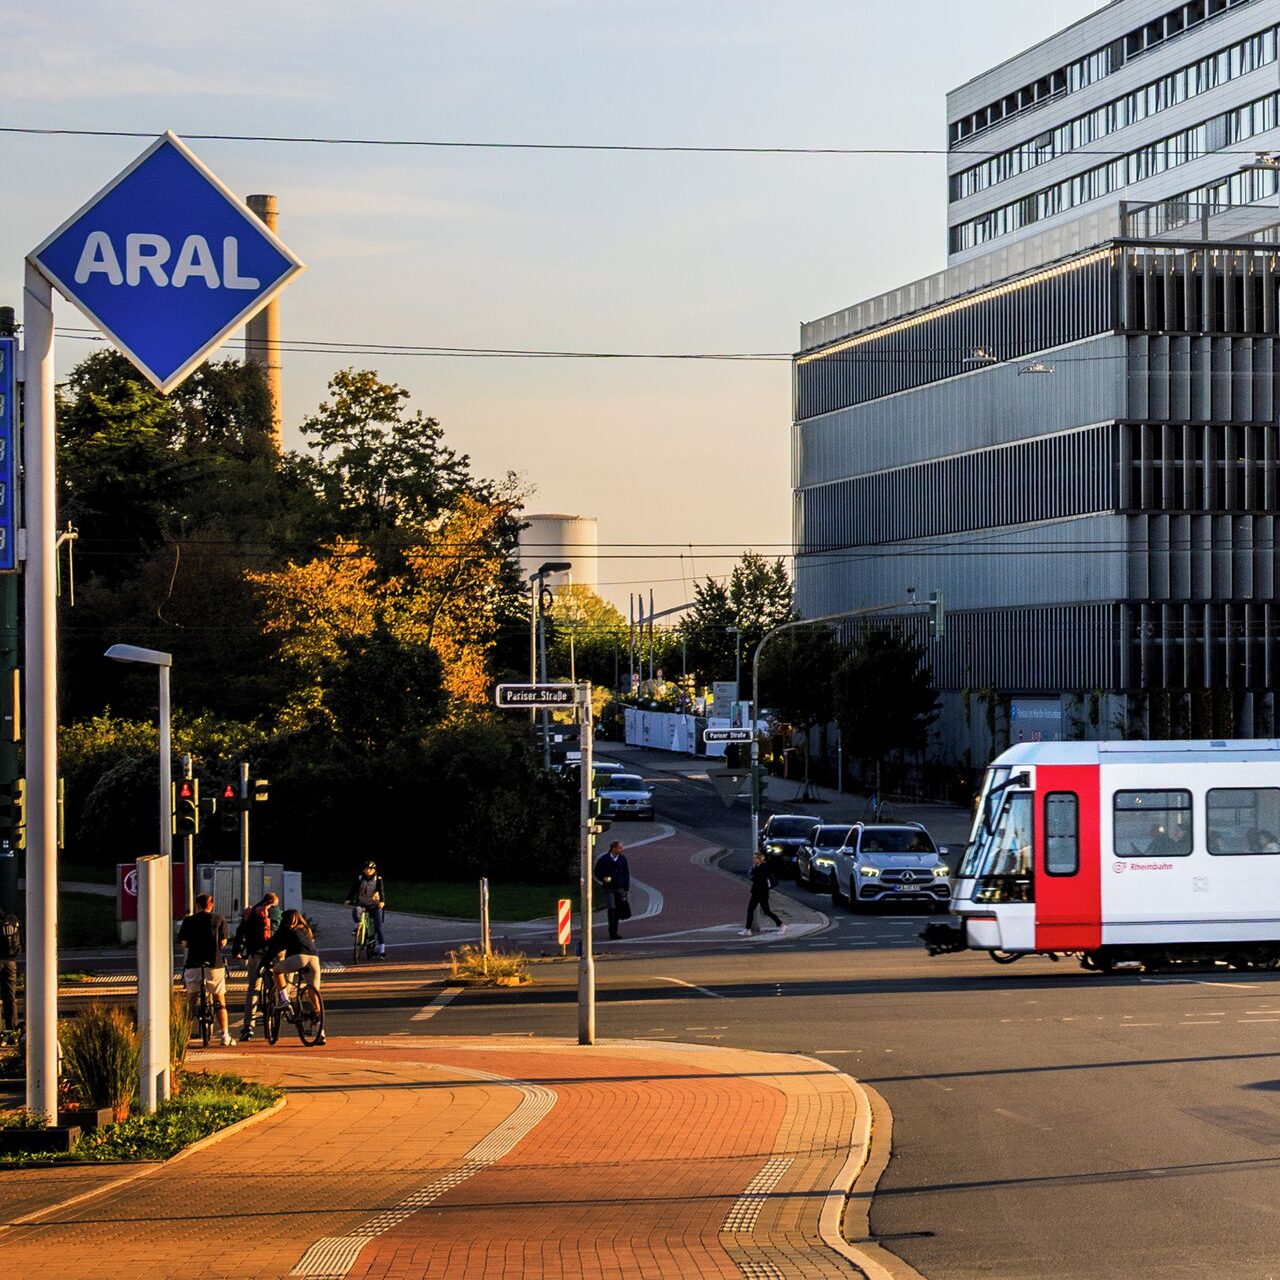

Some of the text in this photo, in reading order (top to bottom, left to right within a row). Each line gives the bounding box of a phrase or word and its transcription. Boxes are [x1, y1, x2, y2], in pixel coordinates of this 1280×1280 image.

[74, 230, 261, 291] ARAL
[507, 690, 567, 702] Pariser Straße
